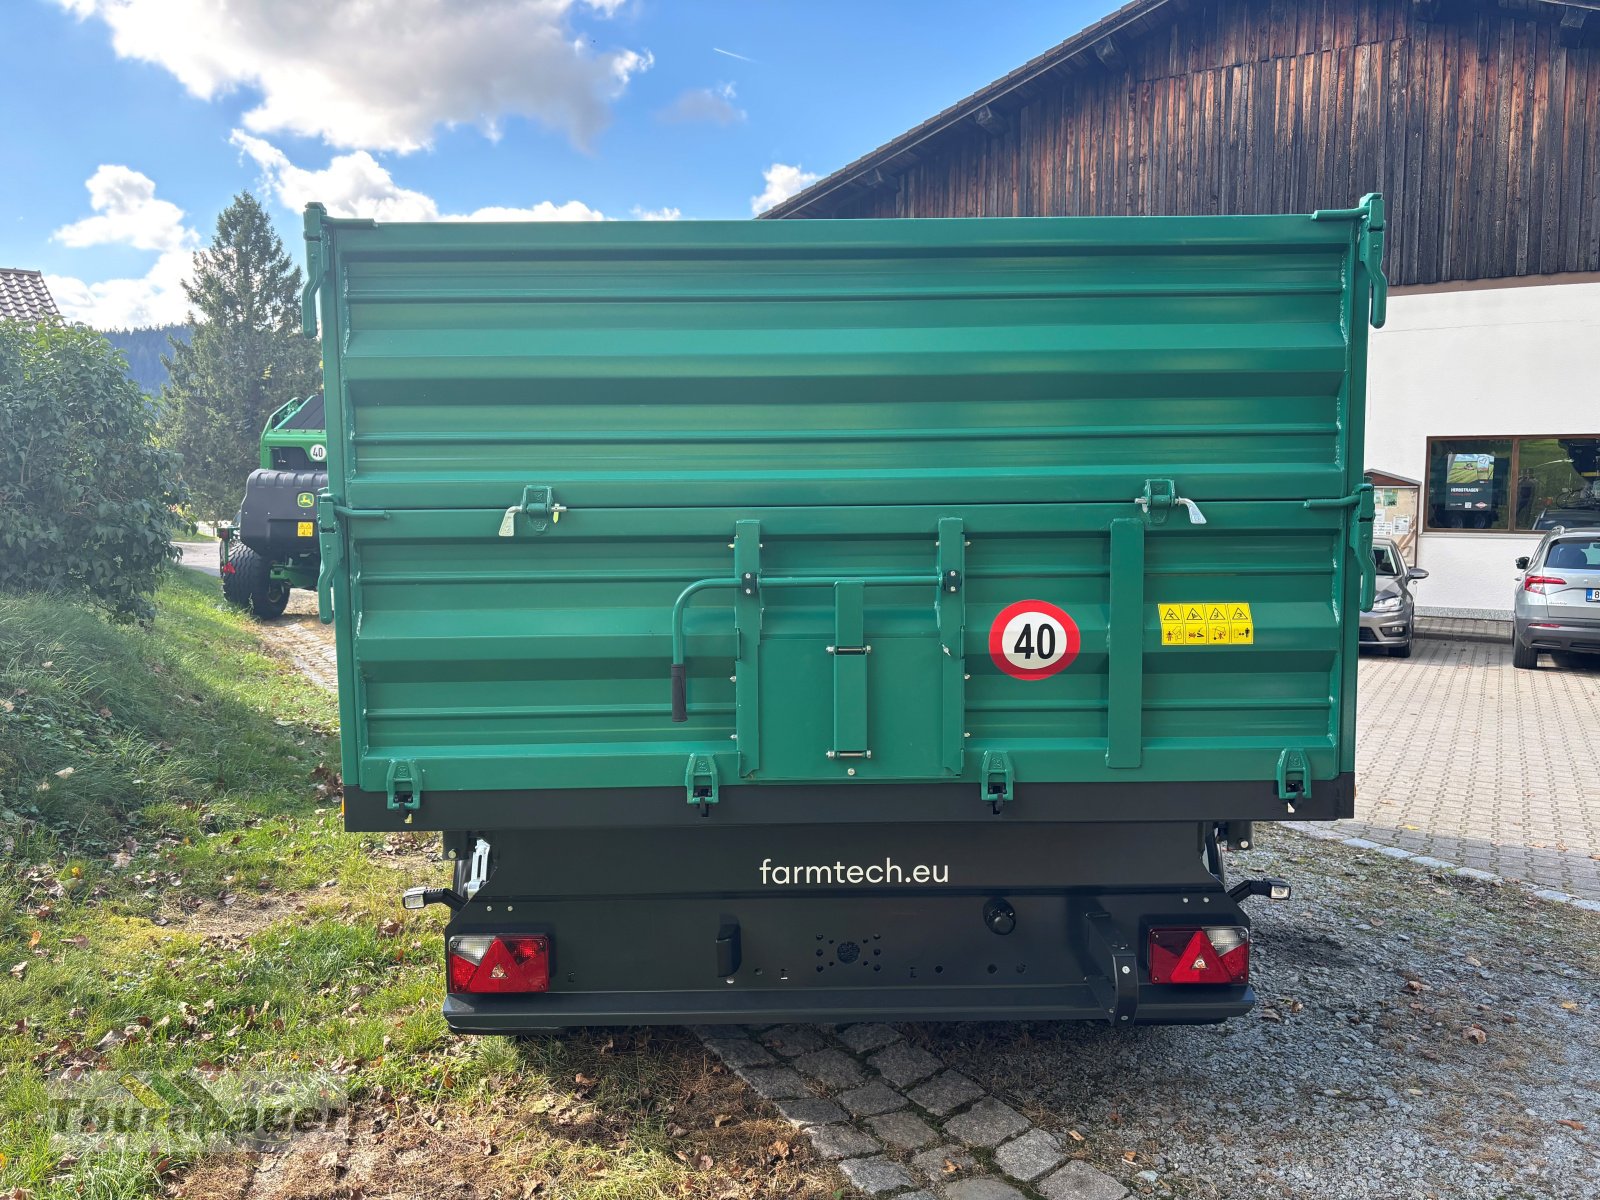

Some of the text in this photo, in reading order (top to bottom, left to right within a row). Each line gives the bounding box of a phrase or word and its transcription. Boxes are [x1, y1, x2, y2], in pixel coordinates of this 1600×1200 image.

[313, 447, 323, 457] 40
[1013, 623, 1056, 660] 40
[759, 857, 949, 885] farmtech.eu
